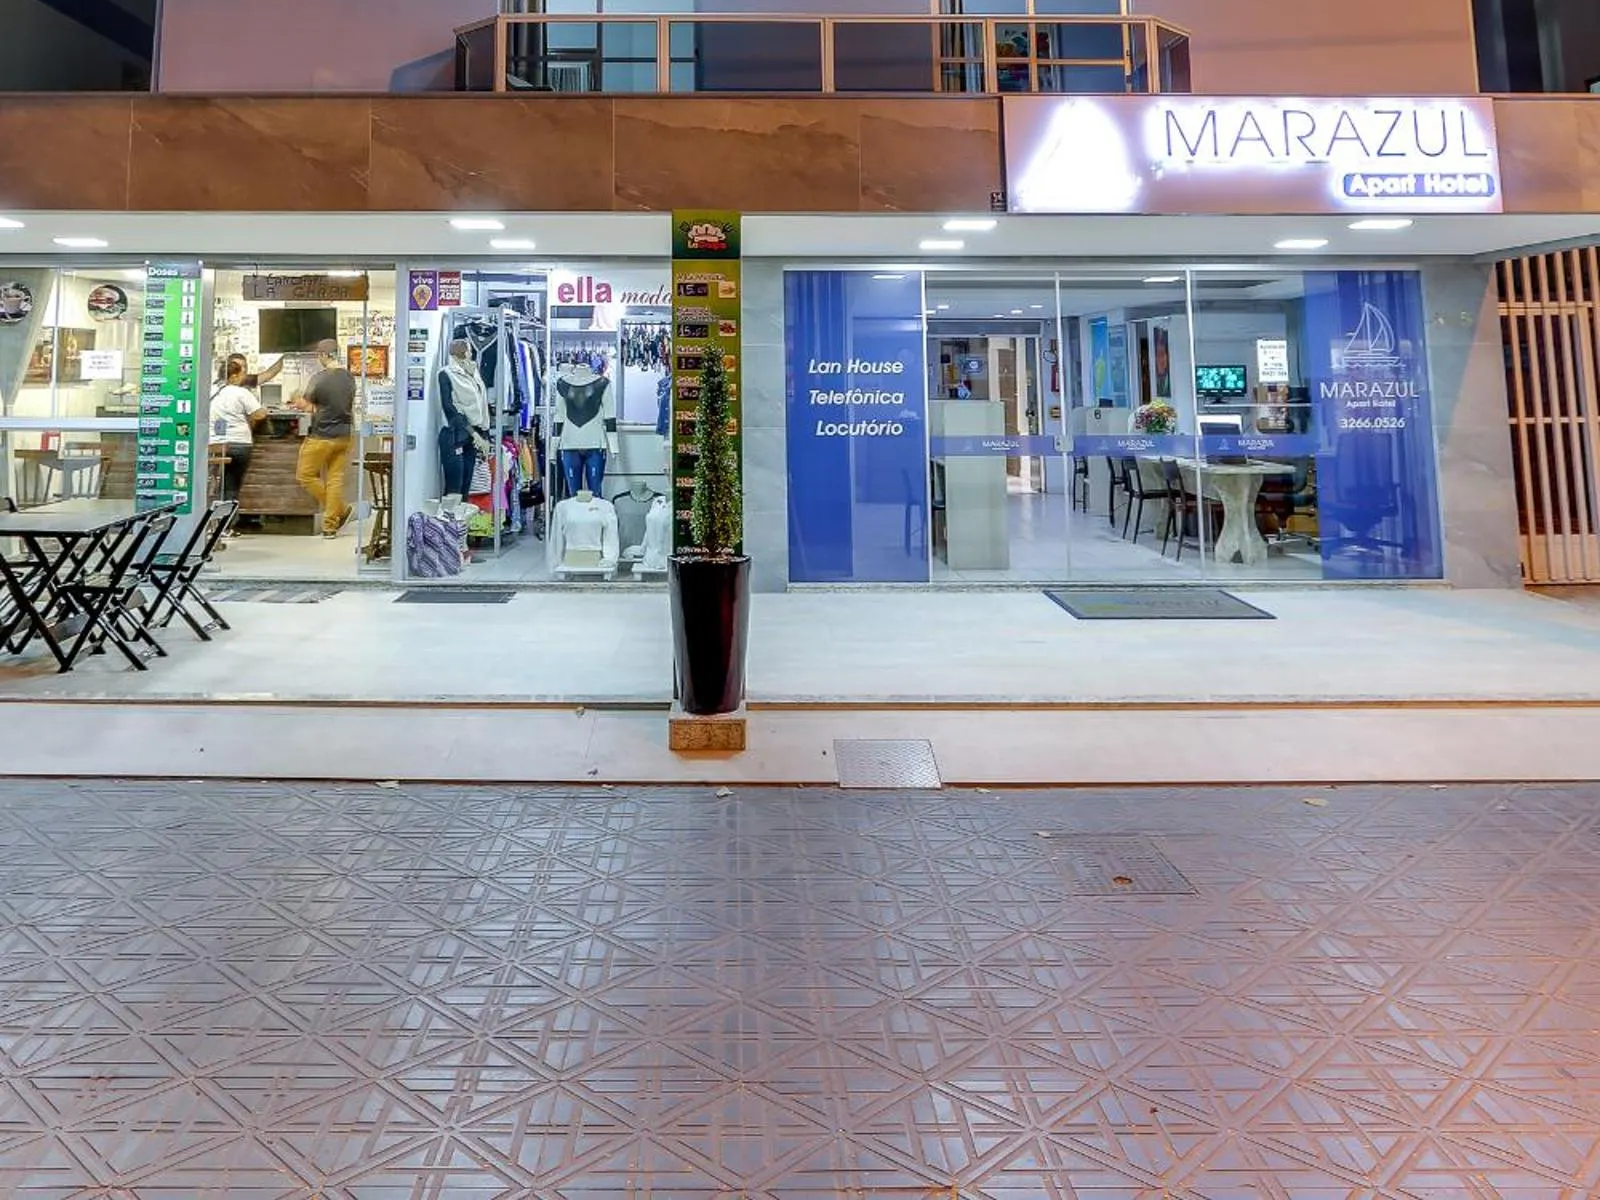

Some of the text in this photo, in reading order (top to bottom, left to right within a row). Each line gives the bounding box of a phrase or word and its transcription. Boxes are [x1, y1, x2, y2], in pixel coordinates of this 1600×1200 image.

[1165, 109, 1488, 157] MARAZUL
[1349, 173, 1488, 196] Apart Hotel
[148, 267, 178, 276] Doses
[412, 276, 434, 284] vivo
[253, 284, 275, 298] LA
[558, 276, 612, 303] ella
[809, 359, 904, 374] Lan House
[809, 388, 905, 405] Telefônica
[1320, 381, 1420, 399] MARAZUL
[1346, 400, 1370, 409] Apart
[816, 419, 904, 436] Locutório
[1340, 417, 1406, 428] 3266.0526
[1117, 439, 1156, 448] MARAZUL
[1237, 439, 1275, 447] MARAZUL
